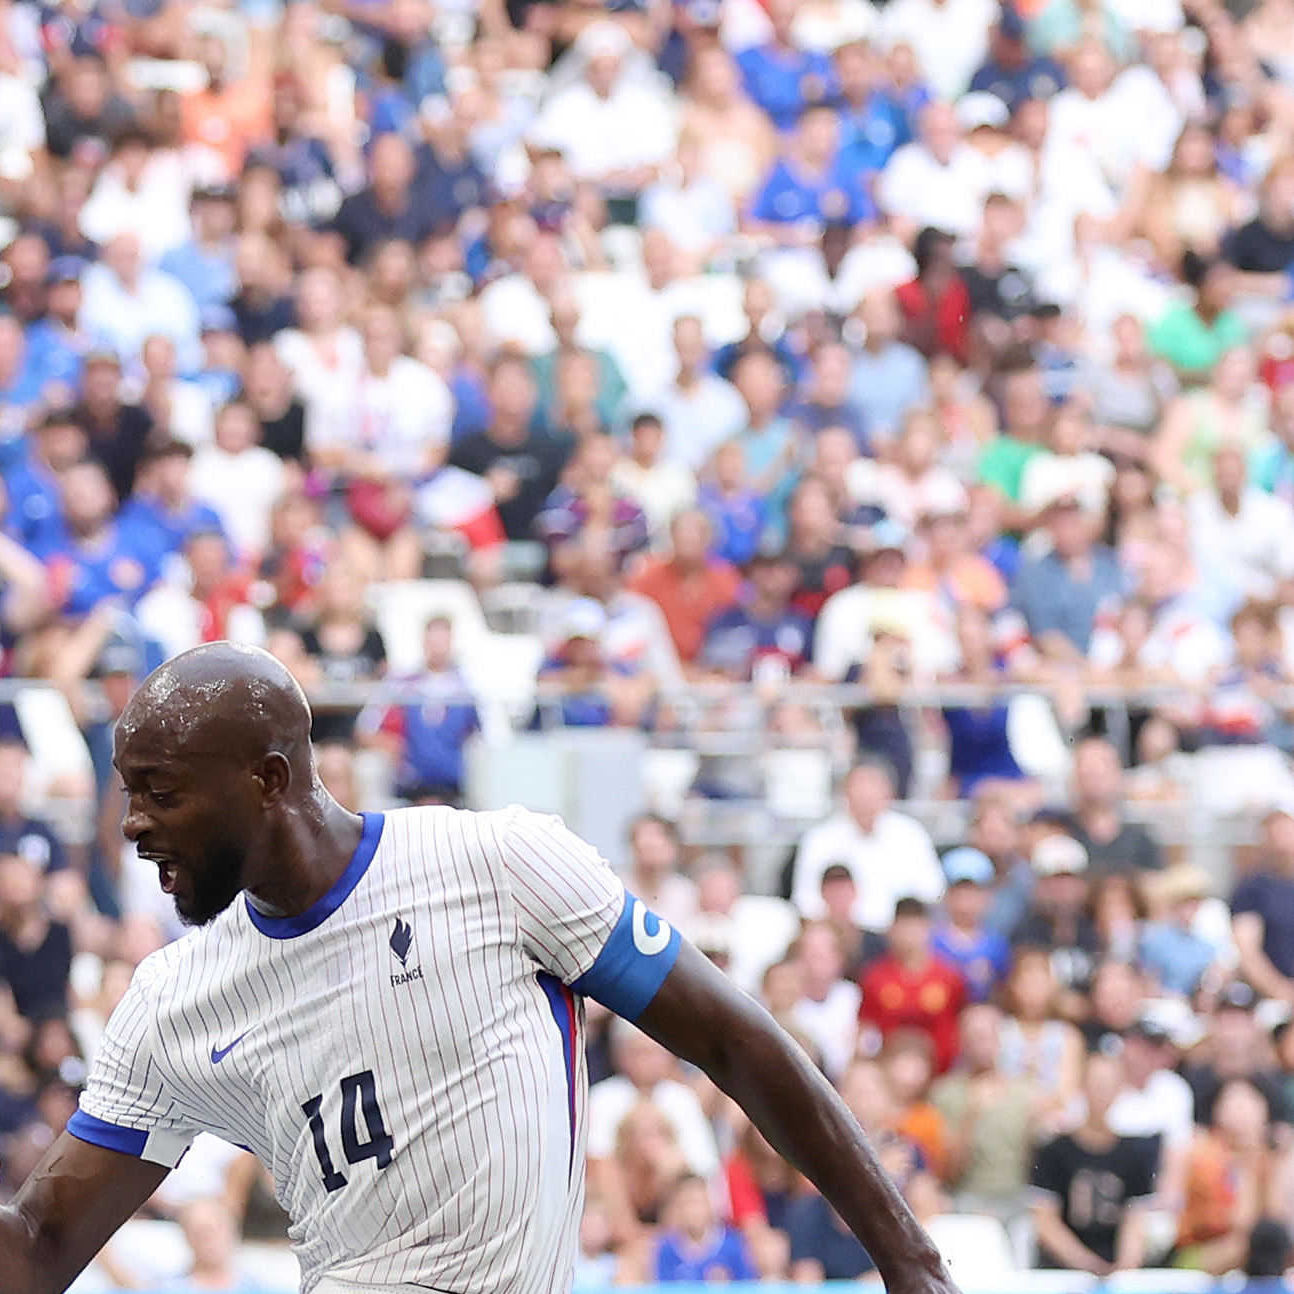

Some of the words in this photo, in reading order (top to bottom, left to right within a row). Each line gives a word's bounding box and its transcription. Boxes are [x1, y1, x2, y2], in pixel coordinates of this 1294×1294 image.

[632, 899, 671, 956] C
[389, 964, 424, 988] FRANCE
[300, 1068, 394, 1194] 14
